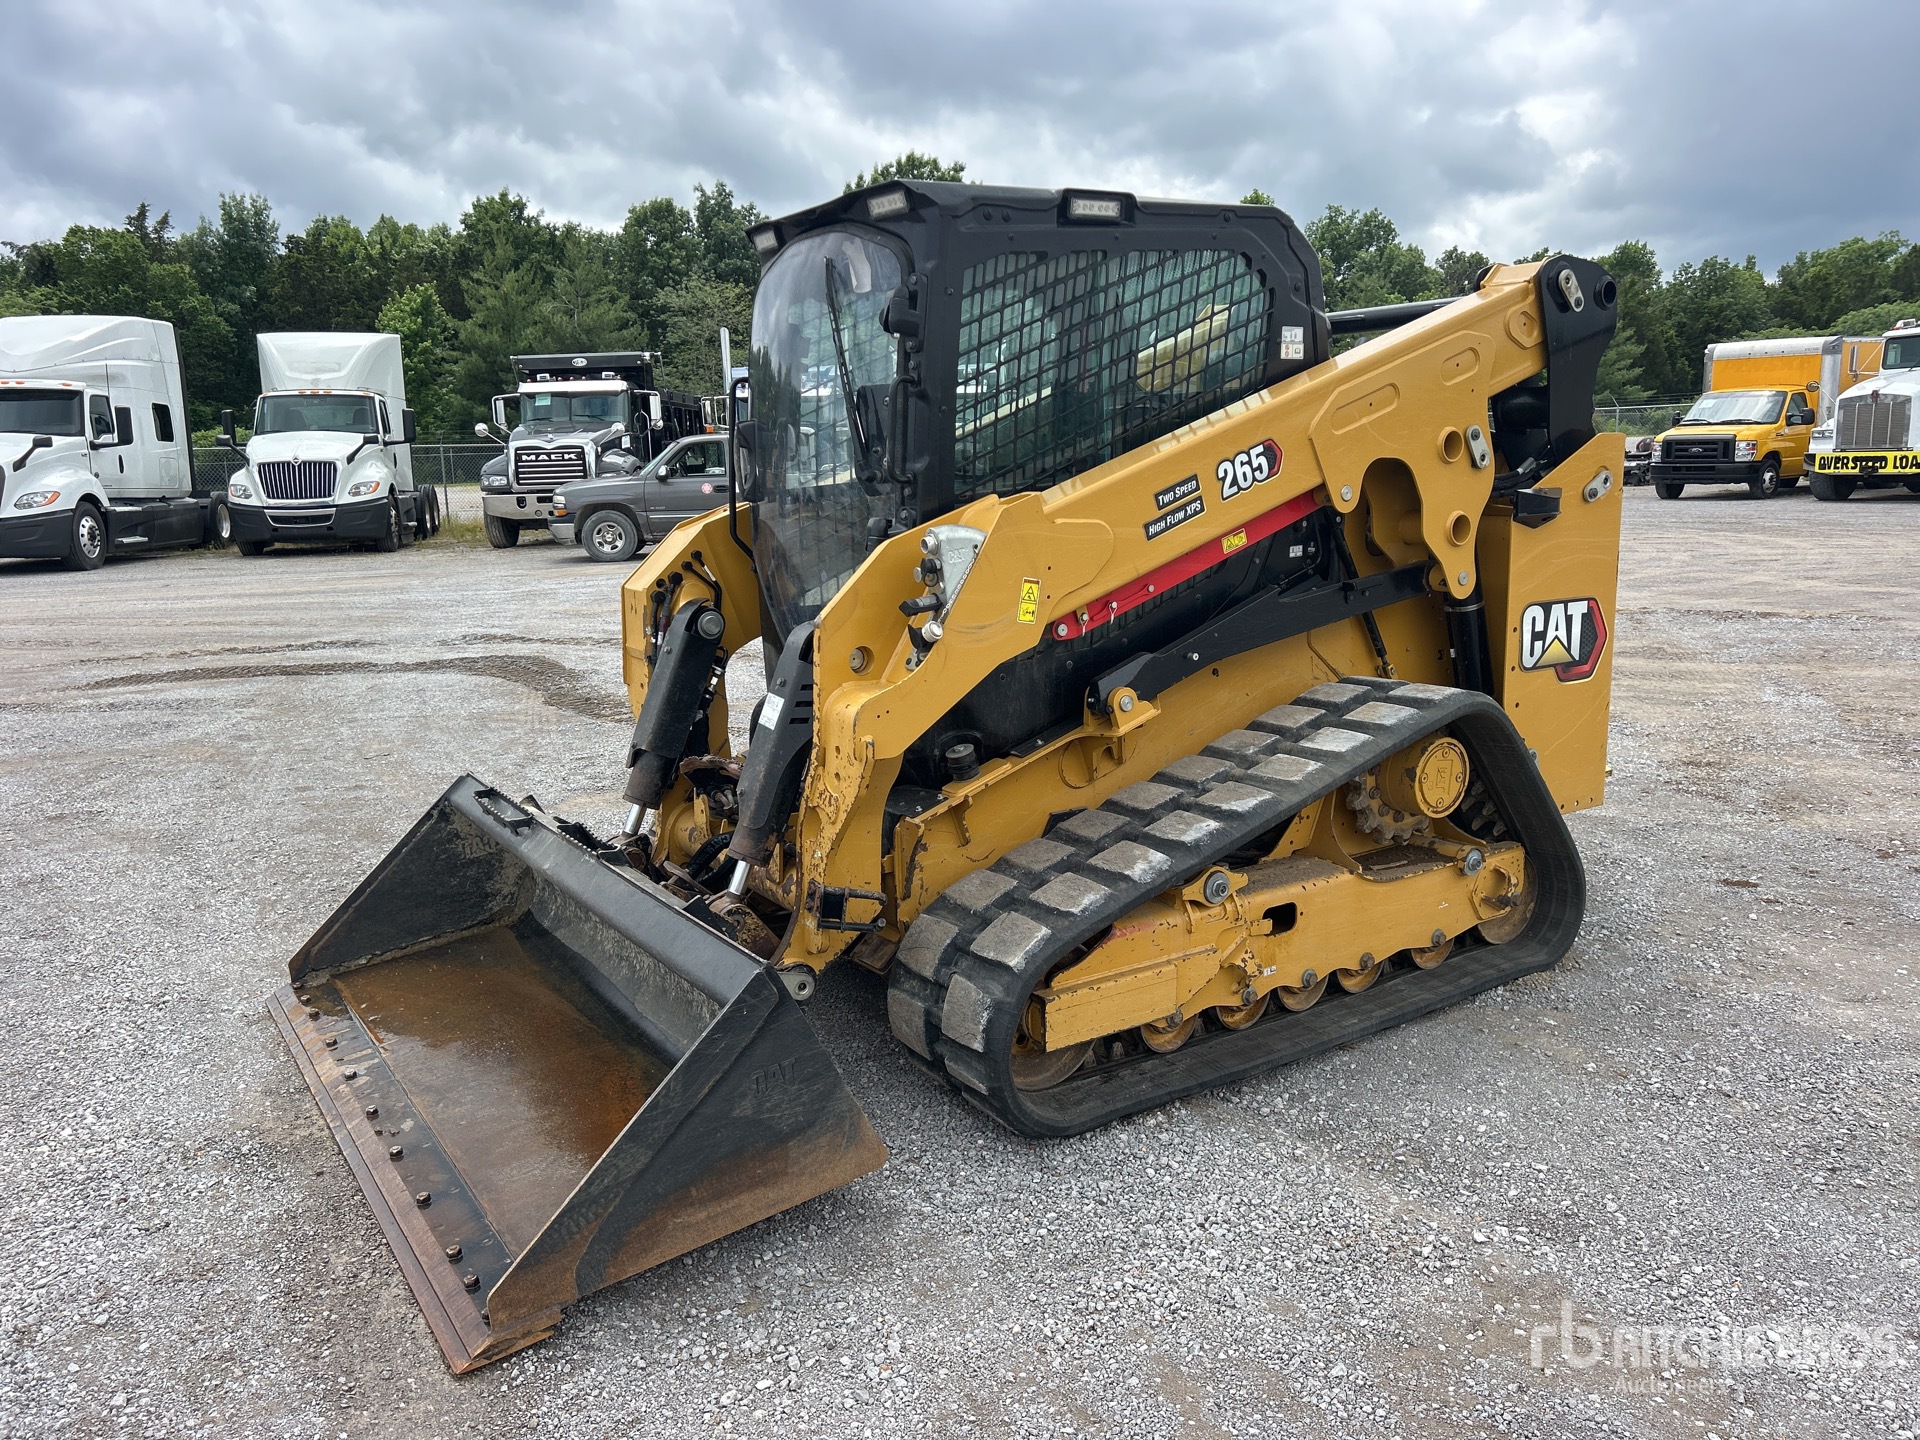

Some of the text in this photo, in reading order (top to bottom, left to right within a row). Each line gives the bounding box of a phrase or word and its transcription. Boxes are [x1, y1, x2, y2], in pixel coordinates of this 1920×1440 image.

[521, 453, 578, 461] MACK
[1218, 444, 1269, 499] 265
[1186, 500, 1201, 517] XPS
[948, 547, 968, 564] CAT
[1522, 600, 1589, 668] CAT
[750, 1057, 797, 1100] CAT
